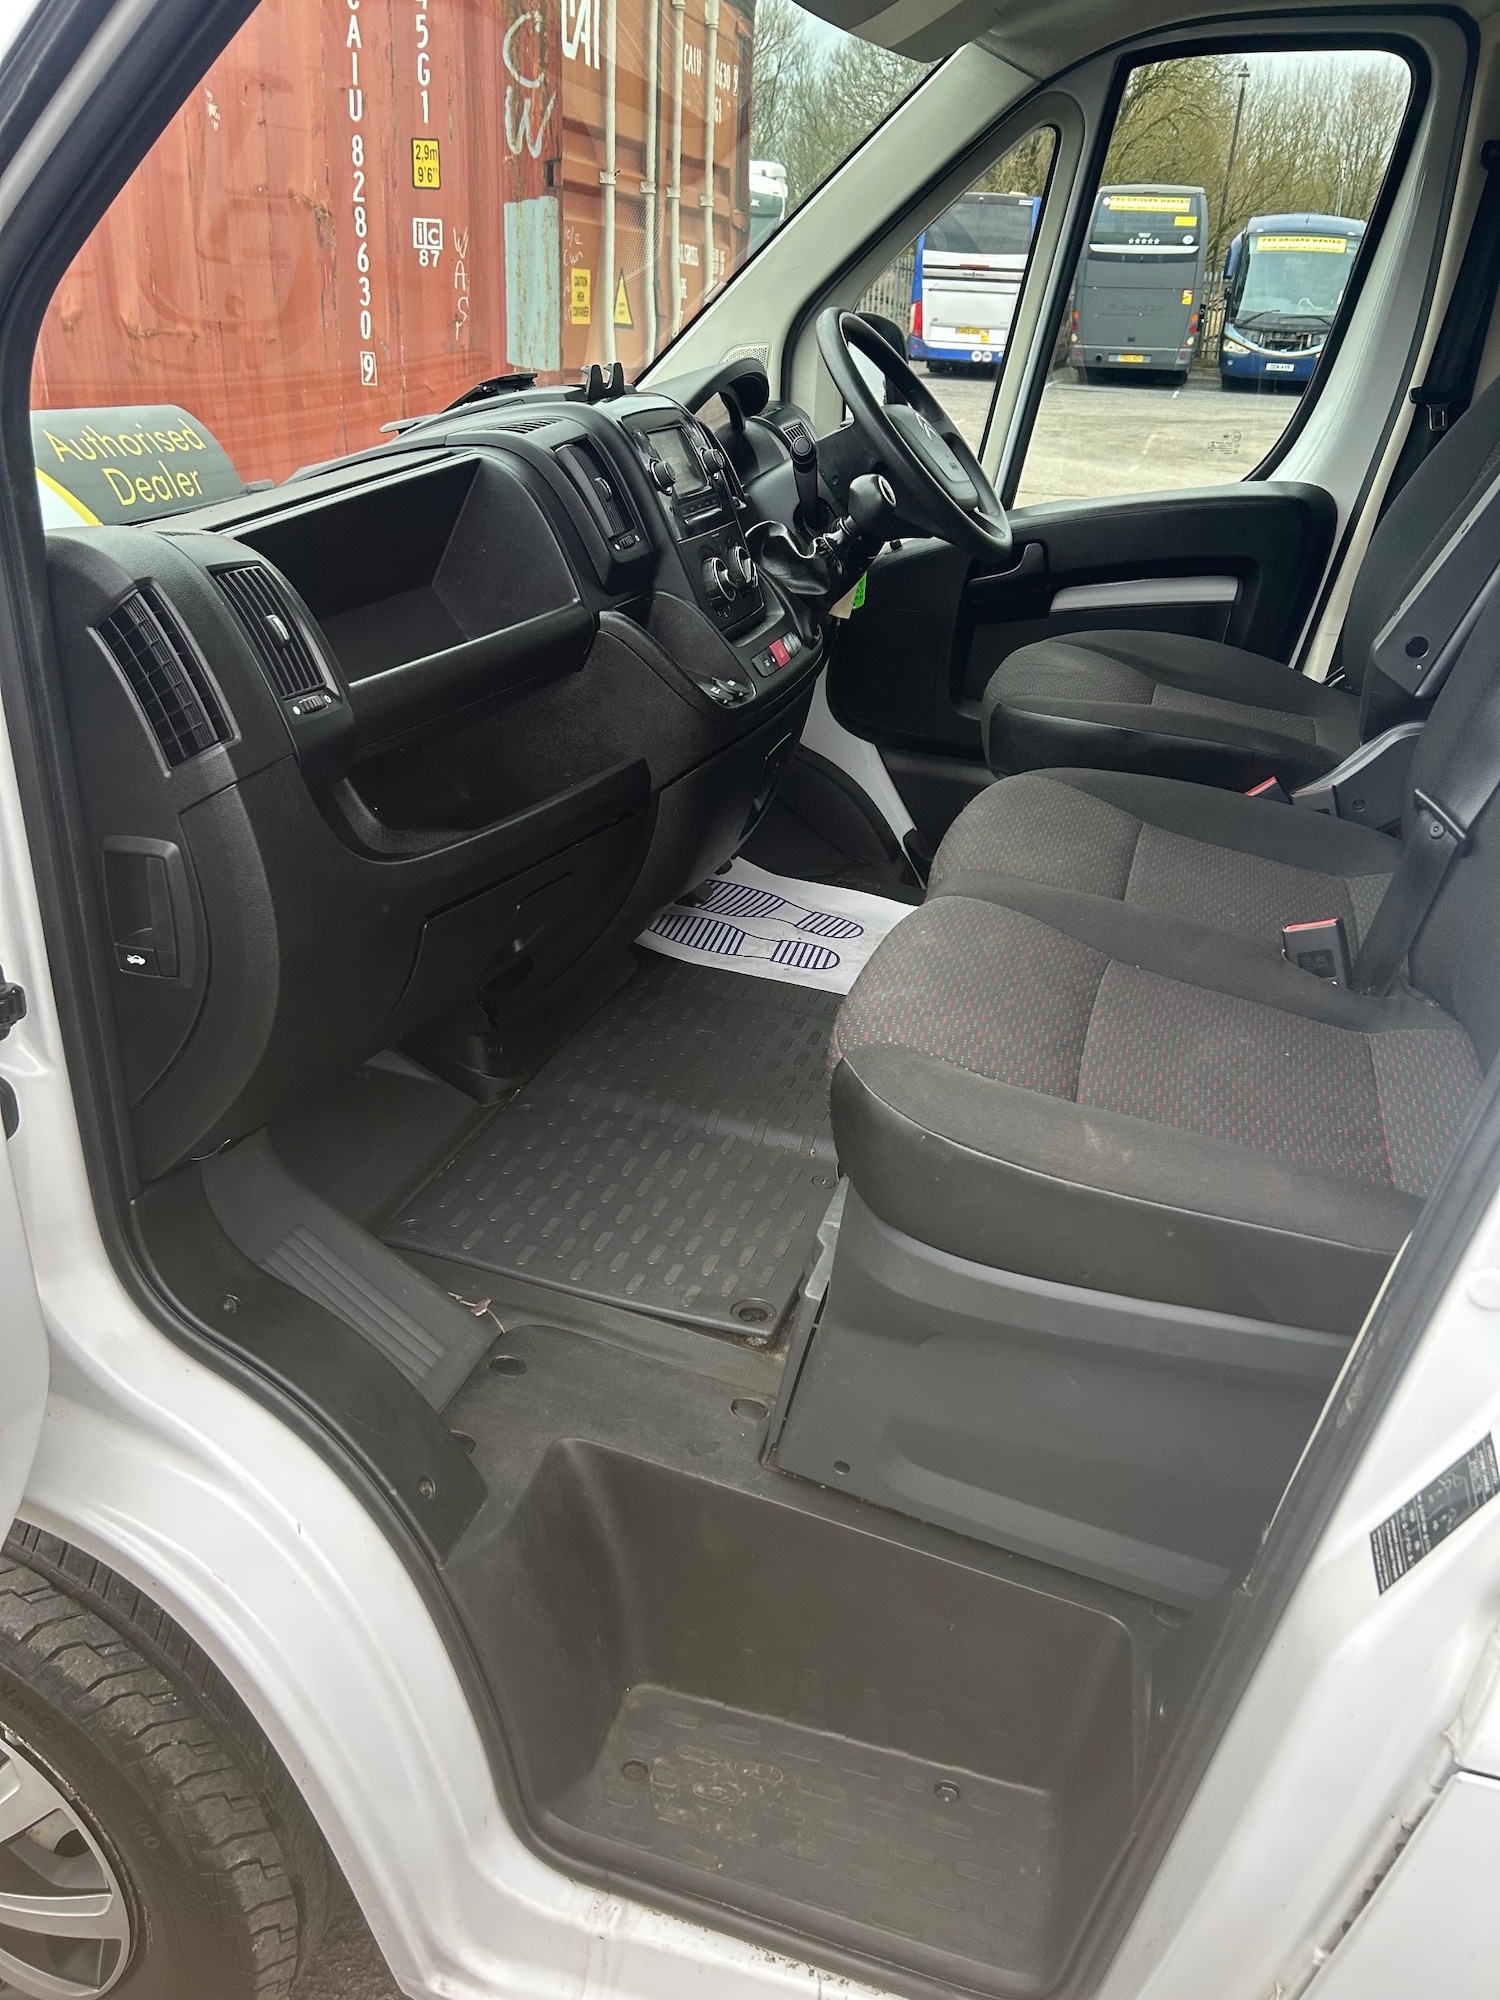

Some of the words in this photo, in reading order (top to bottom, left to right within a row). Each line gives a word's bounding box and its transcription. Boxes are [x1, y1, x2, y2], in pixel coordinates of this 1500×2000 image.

[683, 43, 702, 77] CAIU
[351, 134, 372, 340] 828630
[418, 249, 441, 268] 87
[42, 418, 207, 463] Authorised
[102, 460, 203, 506] Dealer
